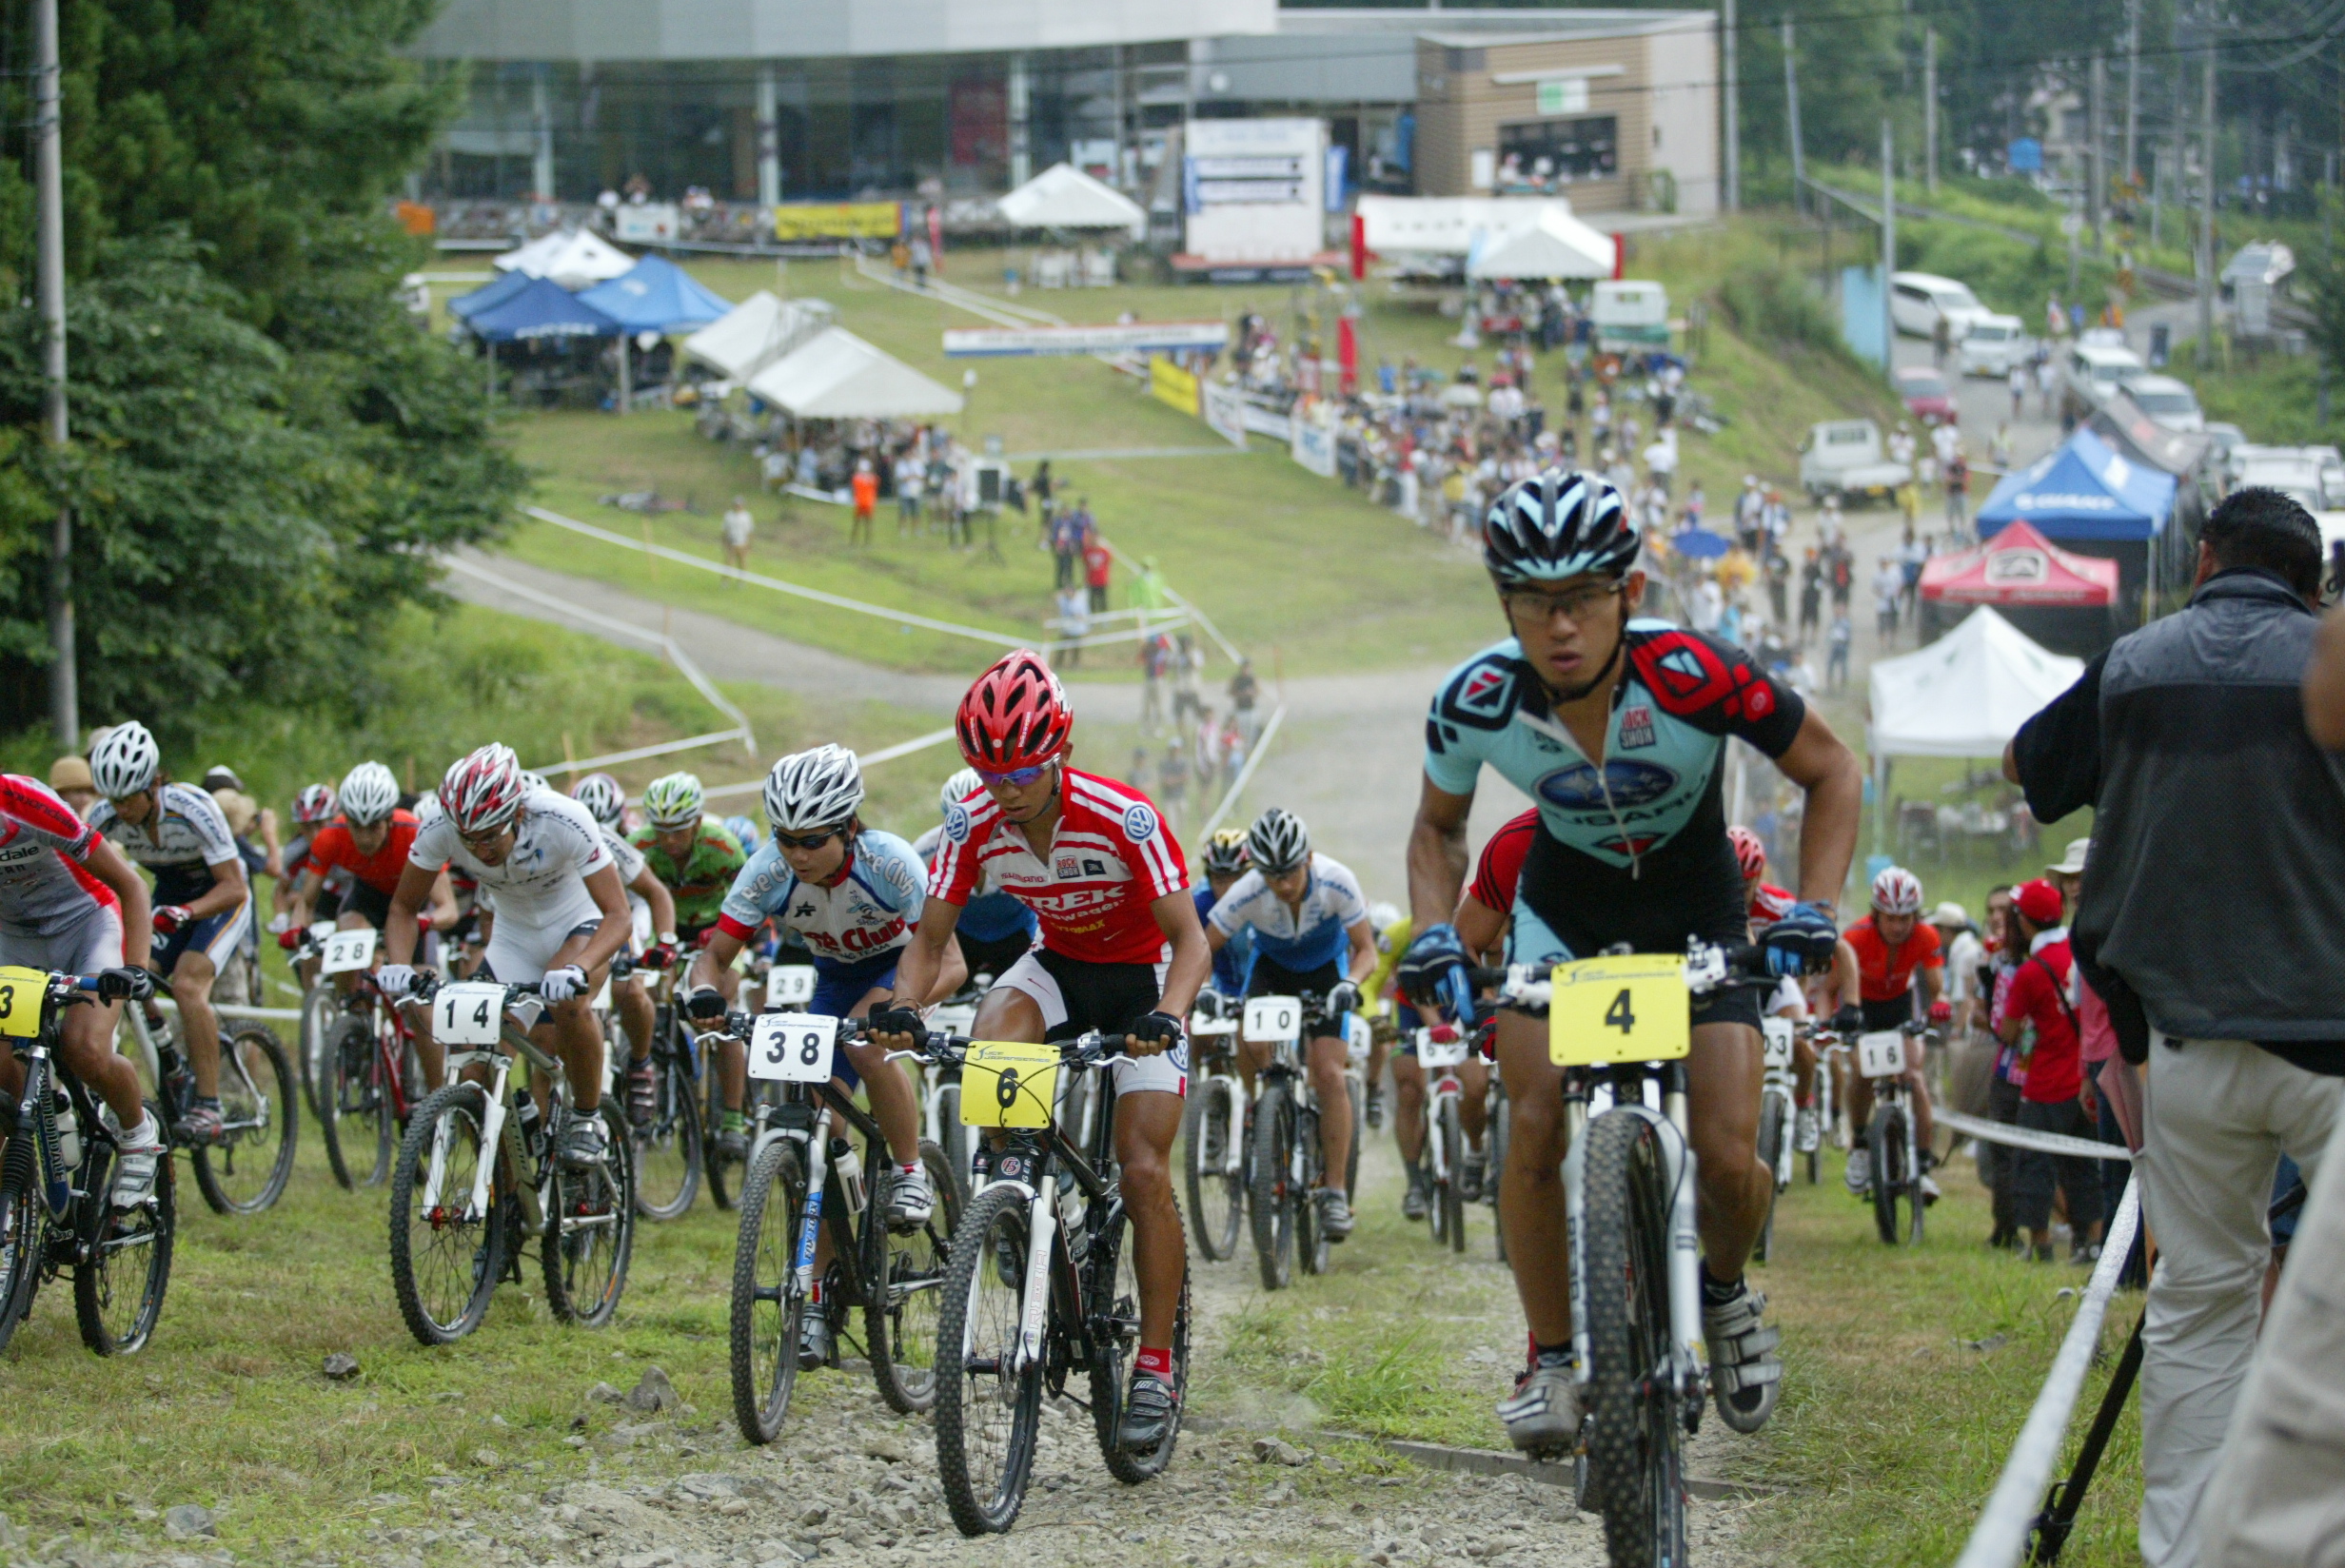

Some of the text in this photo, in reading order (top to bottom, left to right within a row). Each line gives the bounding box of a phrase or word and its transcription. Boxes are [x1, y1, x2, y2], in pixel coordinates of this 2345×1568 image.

[884, 857, 915, 897] Club
[841, 916, 906, 951] Club
[333, 943, 365, 962] 28
[776, 977, 804, 995] 29
[445, 999, 489, 1029] 14
[1253, 1010, 1291, 1030] 10
[1605, 989, 1635, 1034] 4
[766, 1030, 820, 1066] 38
[1867, 1047, 1897, 1066] 16
[996, 1068, 1018, 1108] 6
[41, 1073, 66, 1183] ANNONDALE
